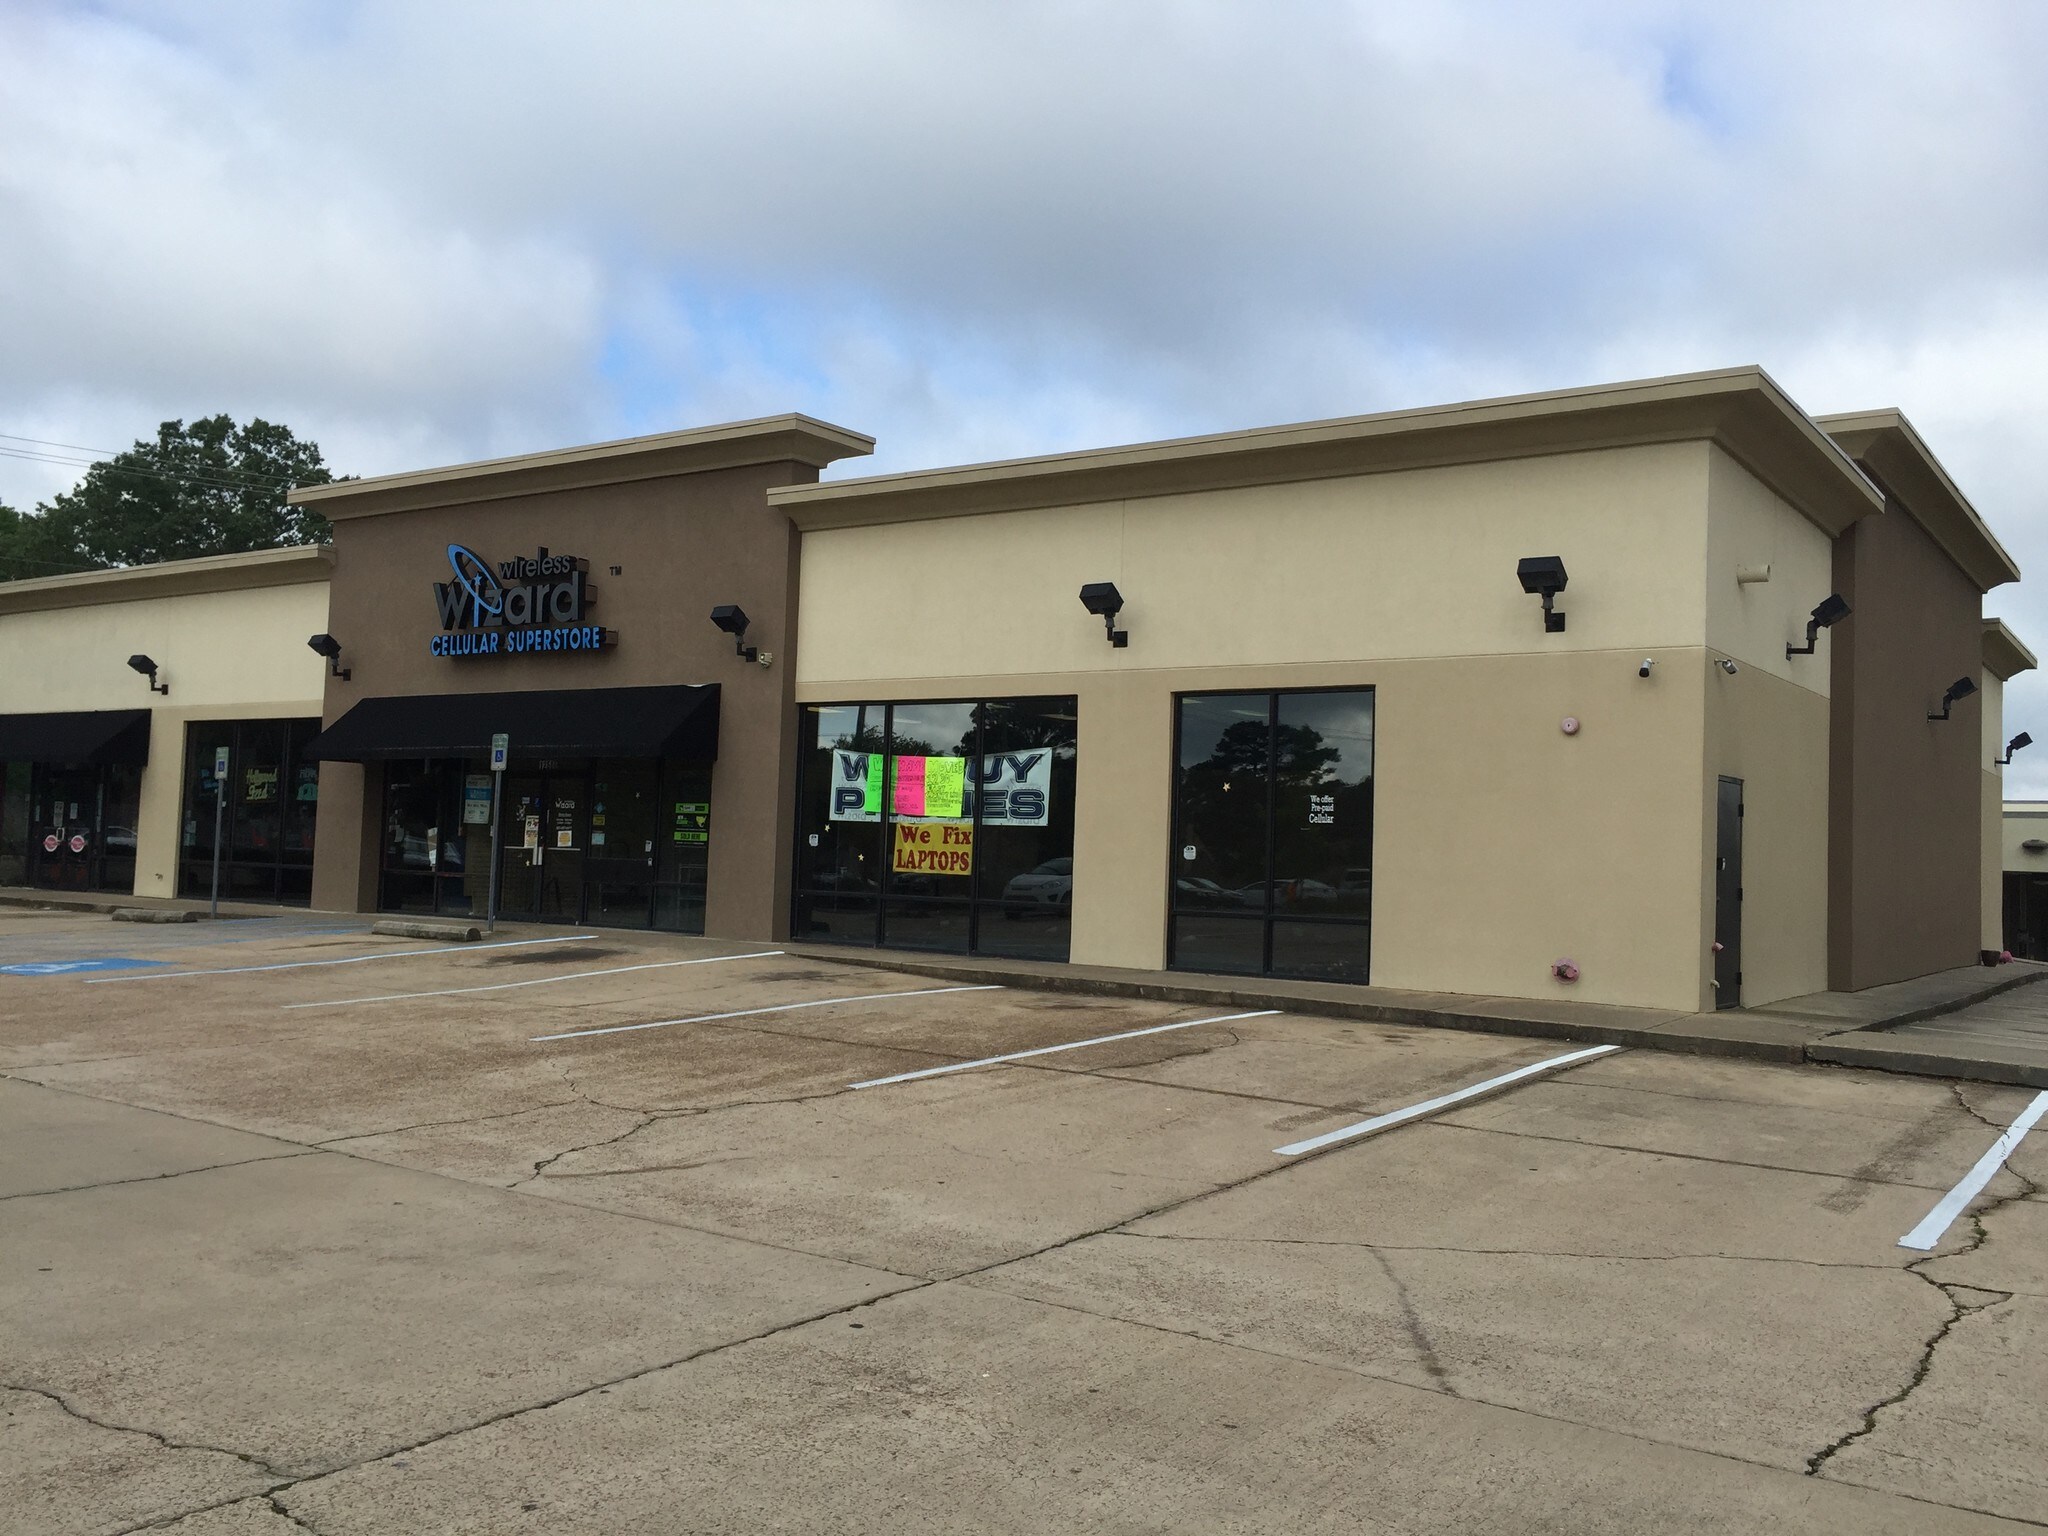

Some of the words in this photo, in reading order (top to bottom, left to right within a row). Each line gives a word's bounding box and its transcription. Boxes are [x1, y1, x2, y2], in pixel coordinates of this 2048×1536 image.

[498, 546, 571, 579] wireless
[430, 632, 500, 657] CELLULAR
[507, 627, 601, 652] SUPERSTORE
[1310, 795, 1320, 803] We
[1321, 795, 1334, 803] offer
[1311, 803, 1334, 813] Pre-paid
[1309, 813, 1334, 824] Cellular
[900, 825, 931, 844] We
[942, 826, 972, 845] Fix
[896, 849, 969, 871] LAPTOPS
